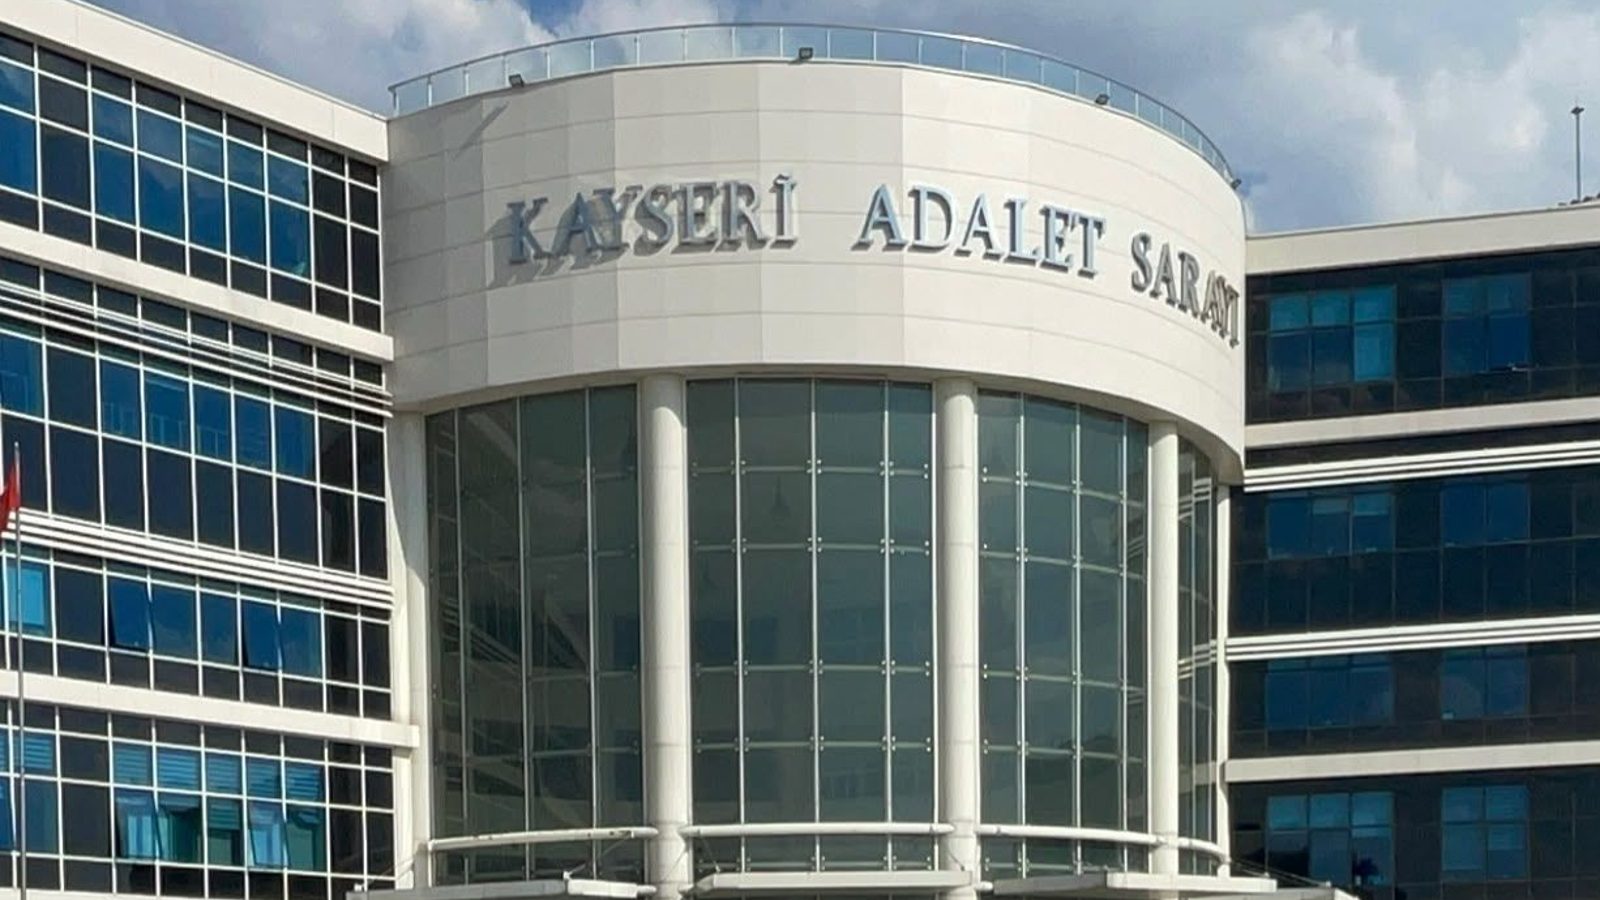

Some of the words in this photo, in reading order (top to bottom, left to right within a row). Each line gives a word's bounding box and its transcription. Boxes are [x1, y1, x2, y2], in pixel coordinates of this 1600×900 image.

[506, 173, 797, 264] KAYSERİ
[851, 183, 1106, 279] ADALET
[1131, 232, 1241, 348] SARAYI
